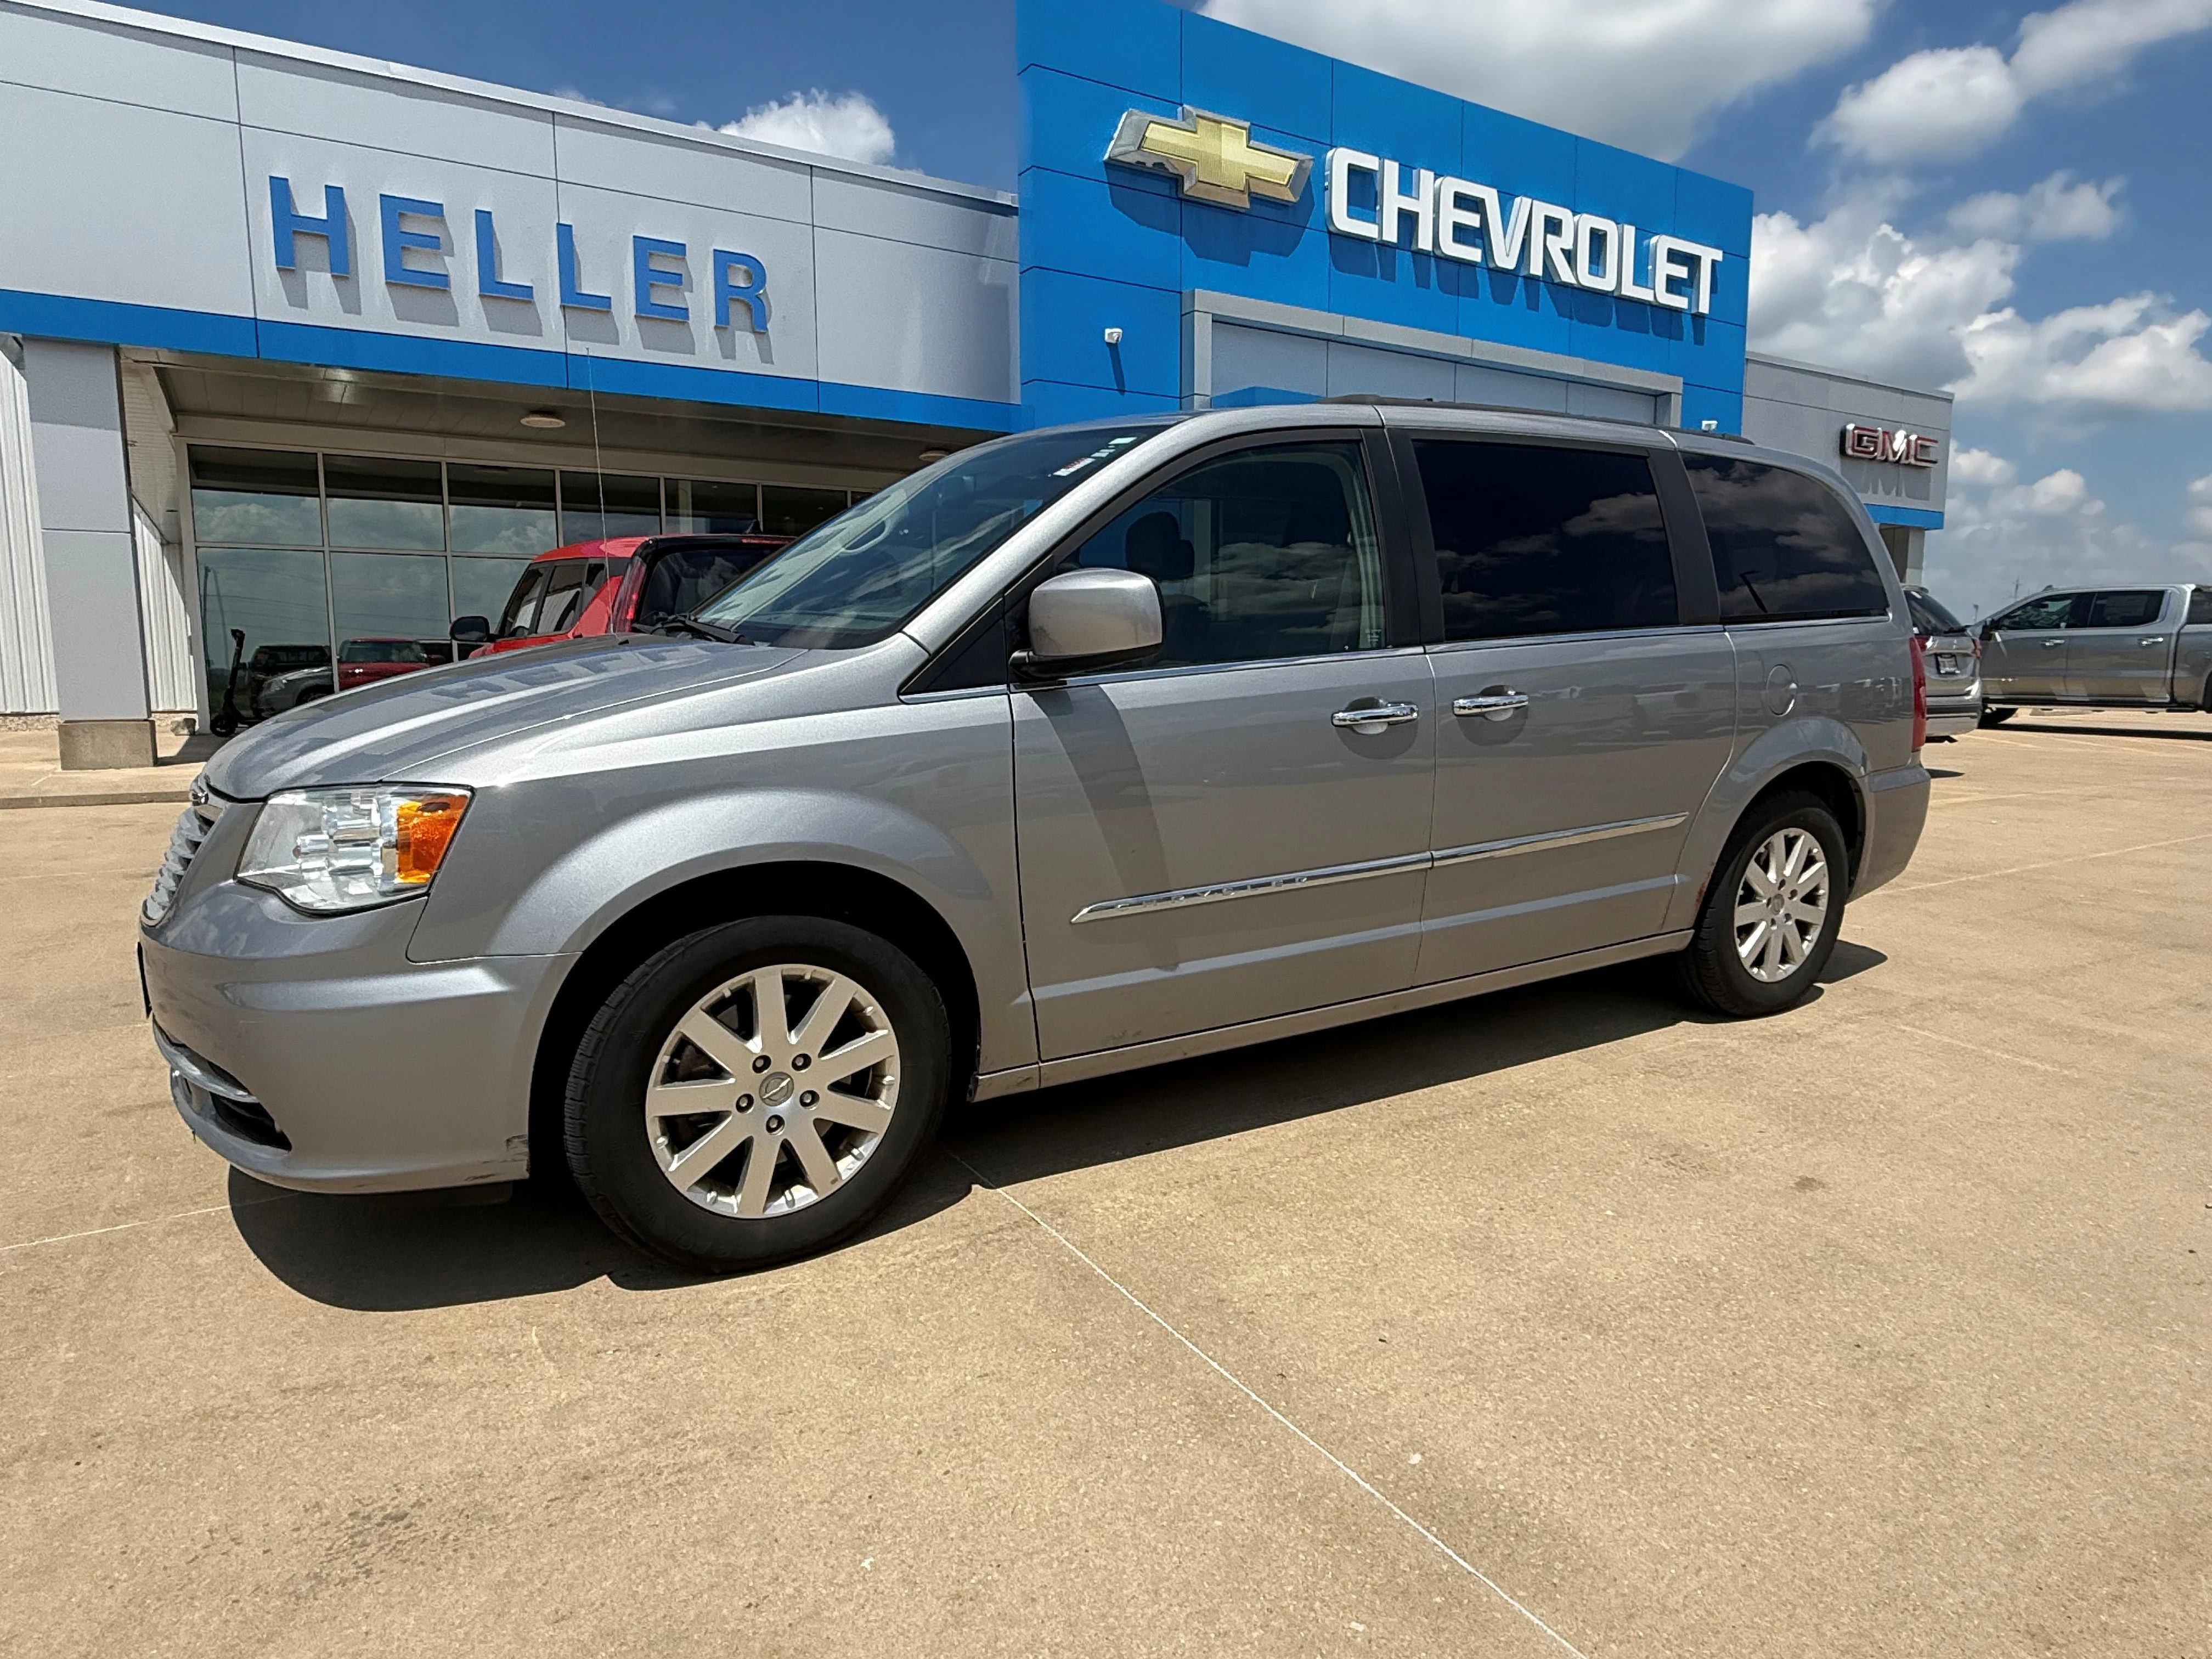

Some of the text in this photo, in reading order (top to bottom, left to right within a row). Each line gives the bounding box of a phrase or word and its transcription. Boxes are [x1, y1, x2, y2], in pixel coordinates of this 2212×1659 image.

[269, 175, 768, 332] HELLER
[1325, 146, 1723, 314] CHEVROLET
[1839, 422, 1939, 468] GMC
[1116, 876, 1308, 911] CHRYSLER
